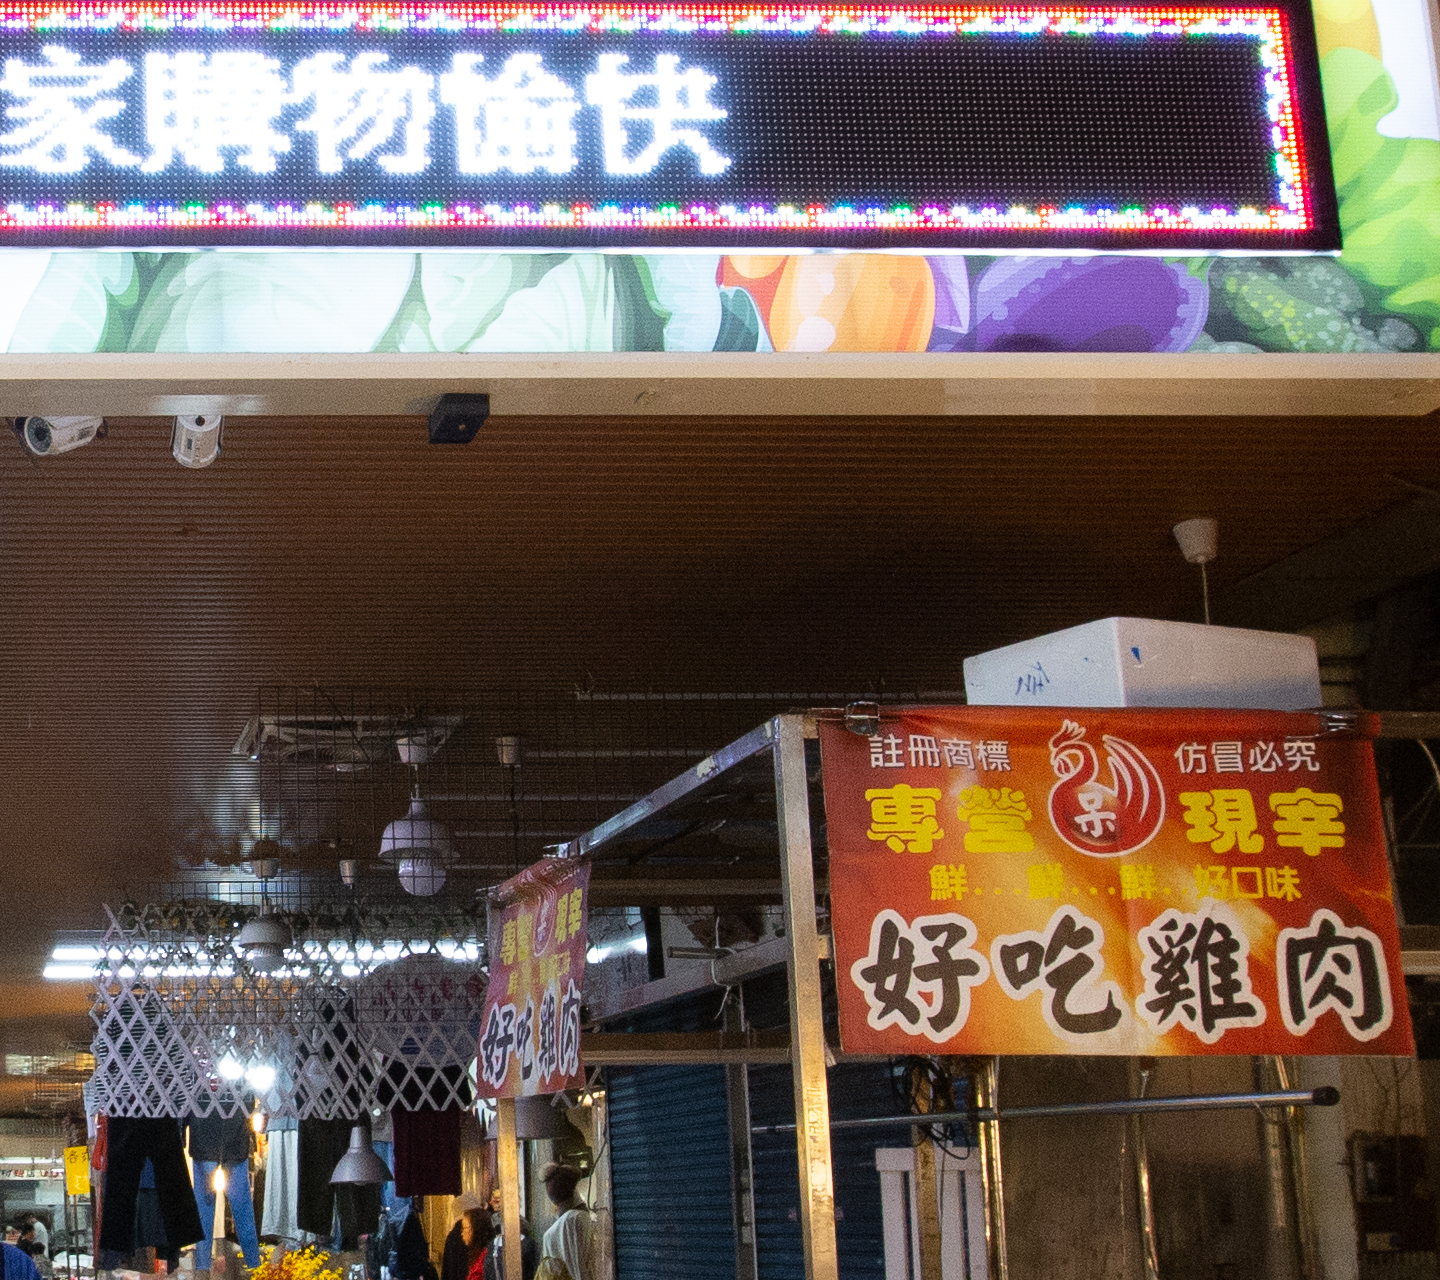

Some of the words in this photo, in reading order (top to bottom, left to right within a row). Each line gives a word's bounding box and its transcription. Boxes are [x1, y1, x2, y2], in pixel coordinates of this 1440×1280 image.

[867, 732, 1012, 773] 註冊商標
[1173, 738, 1320, 774] 仿冒必究
[864, 783, 1036, 855] 專營
[1178, 786, 1346, 858] 現宰
[850, 905, 1394, 1045] 好吃雞肉
[481, 978, 581, 1090] 好吃雞肉
